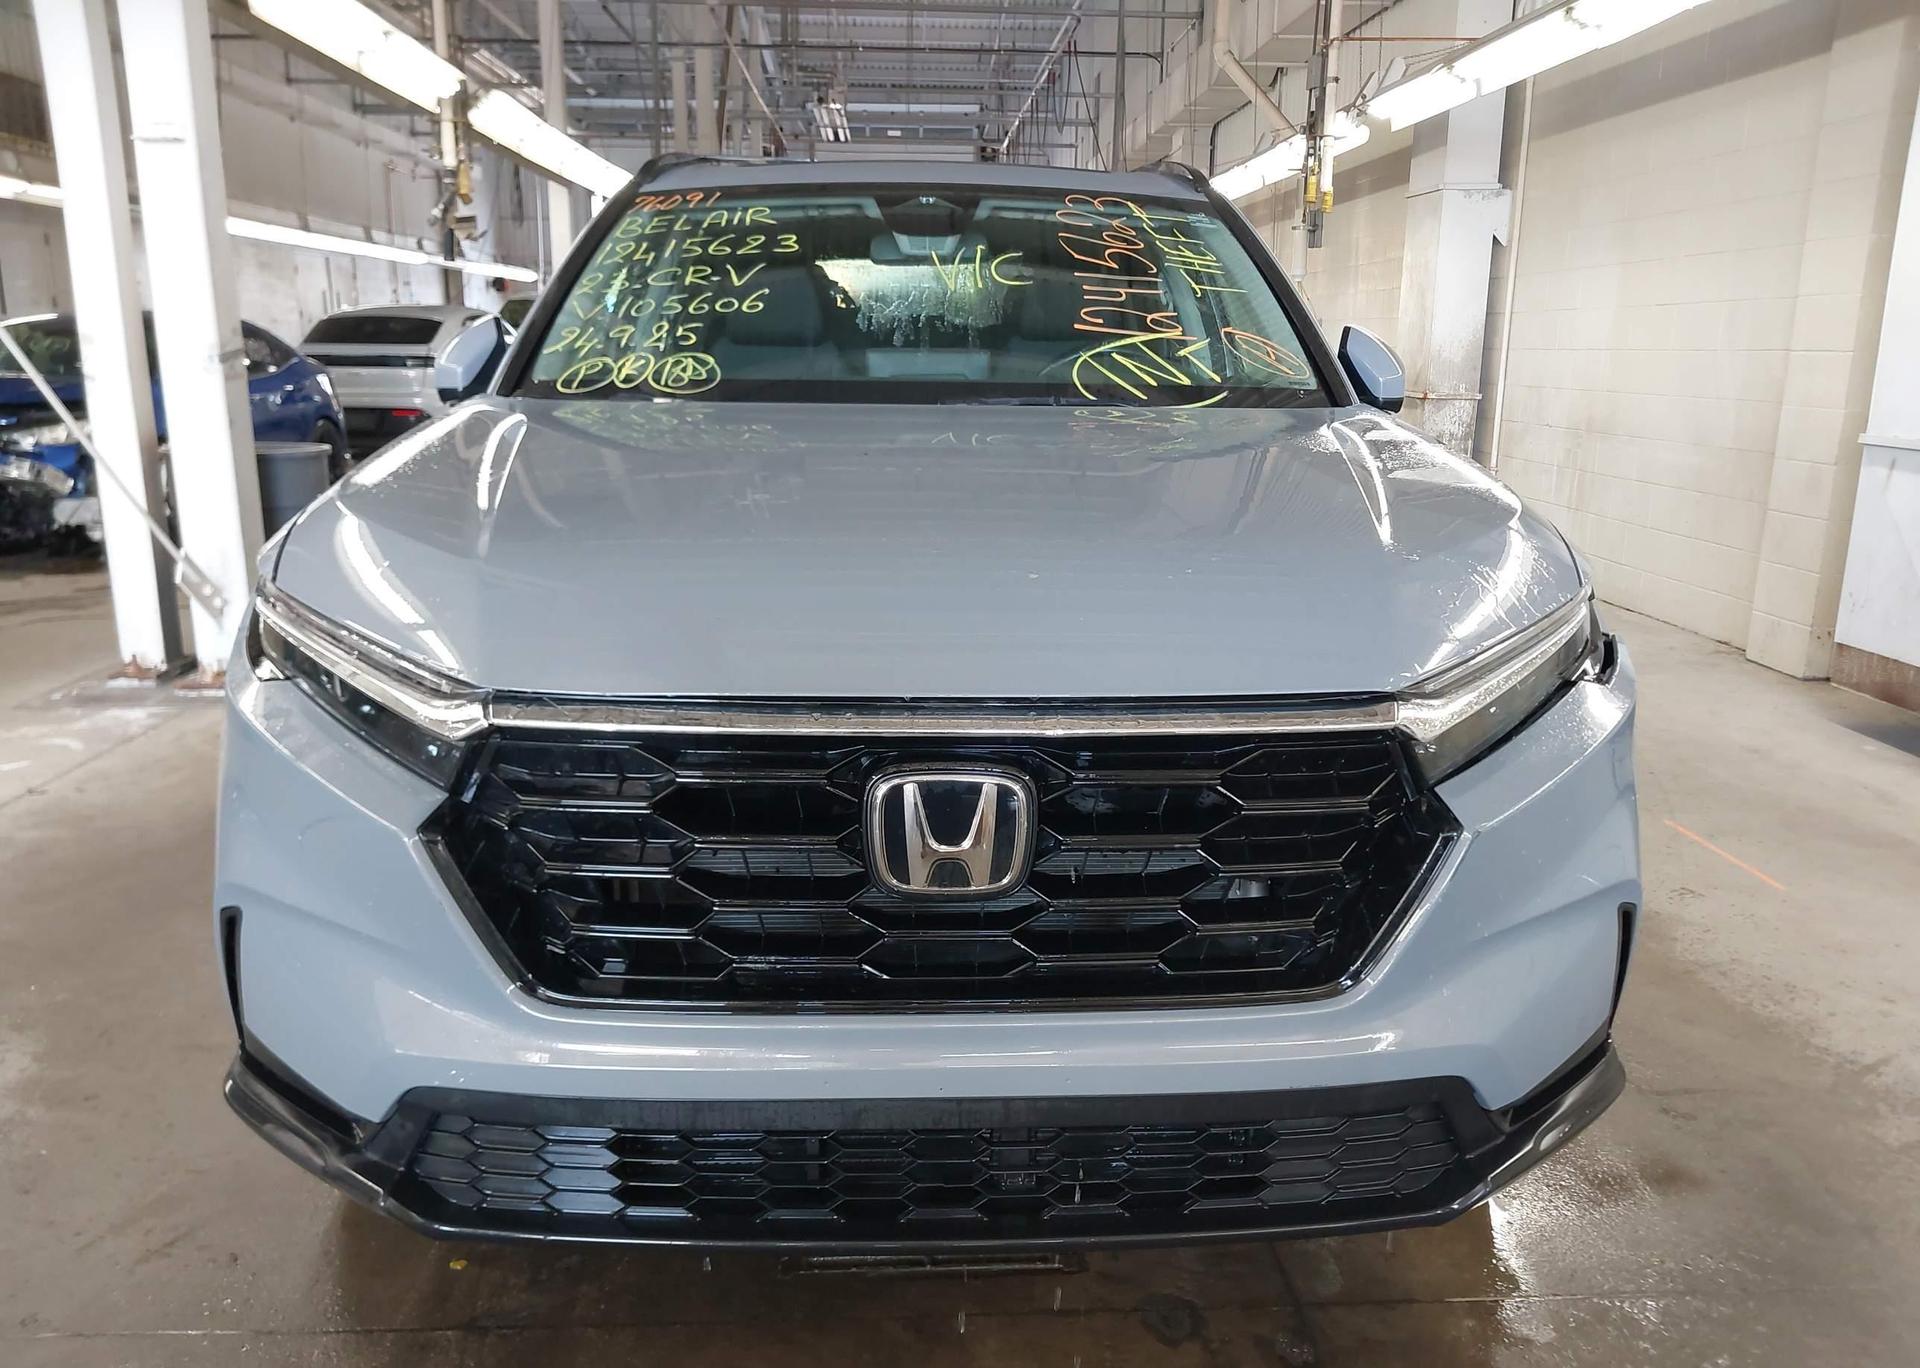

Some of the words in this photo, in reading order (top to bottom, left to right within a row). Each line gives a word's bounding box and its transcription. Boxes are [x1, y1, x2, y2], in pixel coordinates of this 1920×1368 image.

[597, 233, 800, 266] 12415623
[1055, 193, 1198, 341] 12415623
[1127, 201, 1248, 298] THEFT
